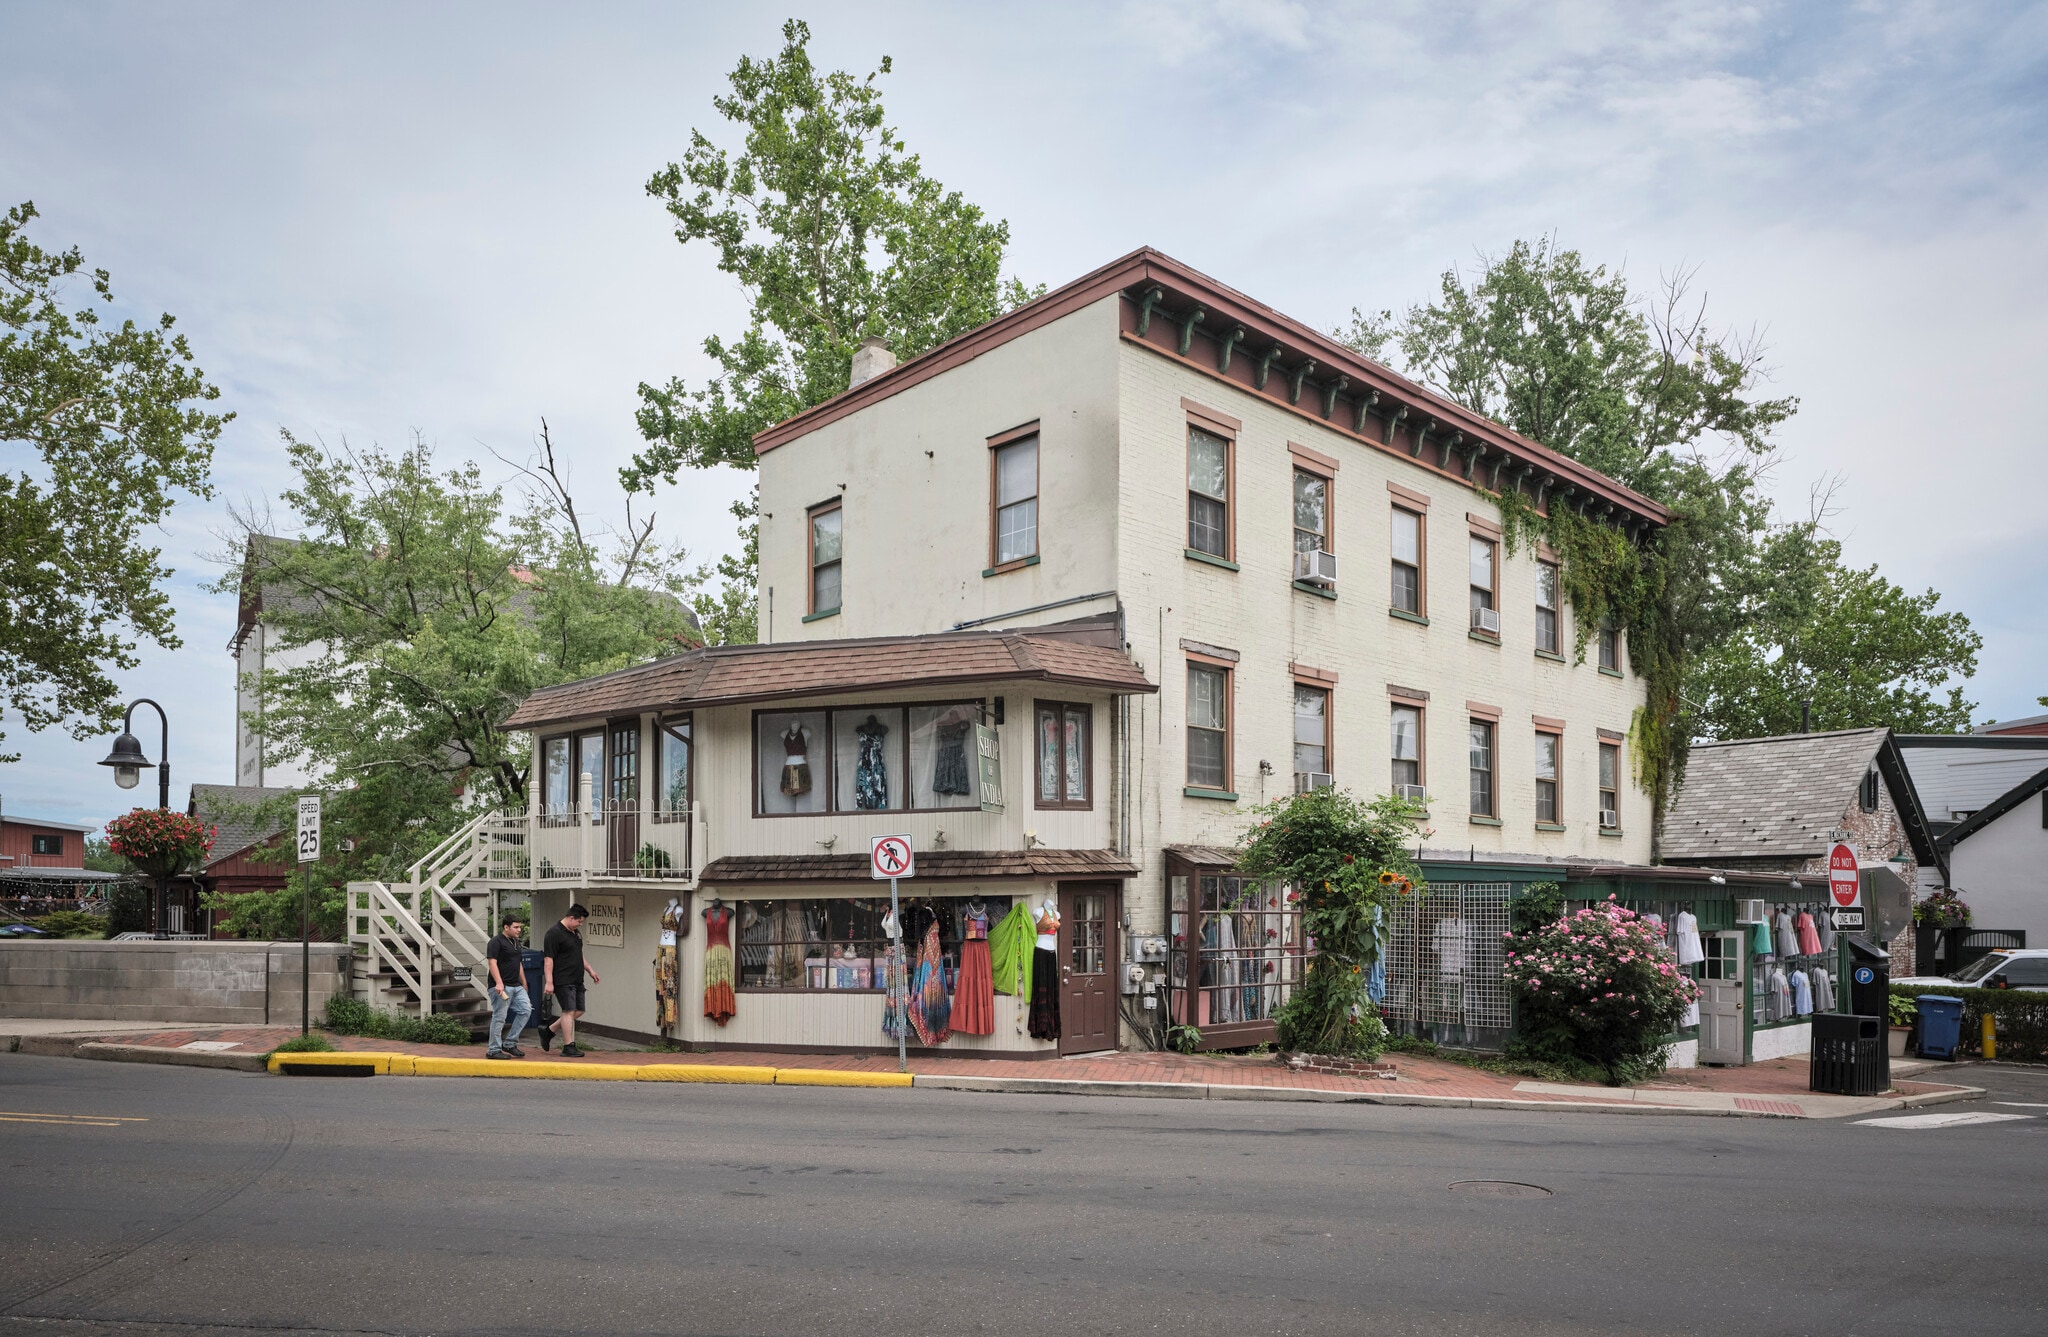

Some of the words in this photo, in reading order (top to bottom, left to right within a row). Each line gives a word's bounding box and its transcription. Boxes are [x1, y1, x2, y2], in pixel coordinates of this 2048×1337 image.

[979, 736, 999, 760] SHOP
[981, 782, 1003, 806] INDIA
[300, 803, 319, 814] SPEED
[302, 816, 316, 827] LIMIT
[300, 829, 318, 854] 25
[1832, 857, 1840, 867] DO
[1841, 857, 1852, 868] NOT
[1835, 884, 1853, 894] ENTER
[591, 904, 618, 918] HENNA
[1838, 914, 1848, 924] ONE
[1849, 914, 1861, 924] WAY
[588, 922, 621, 937] TATTOOS
[1860, 970, 1869, 982] P
